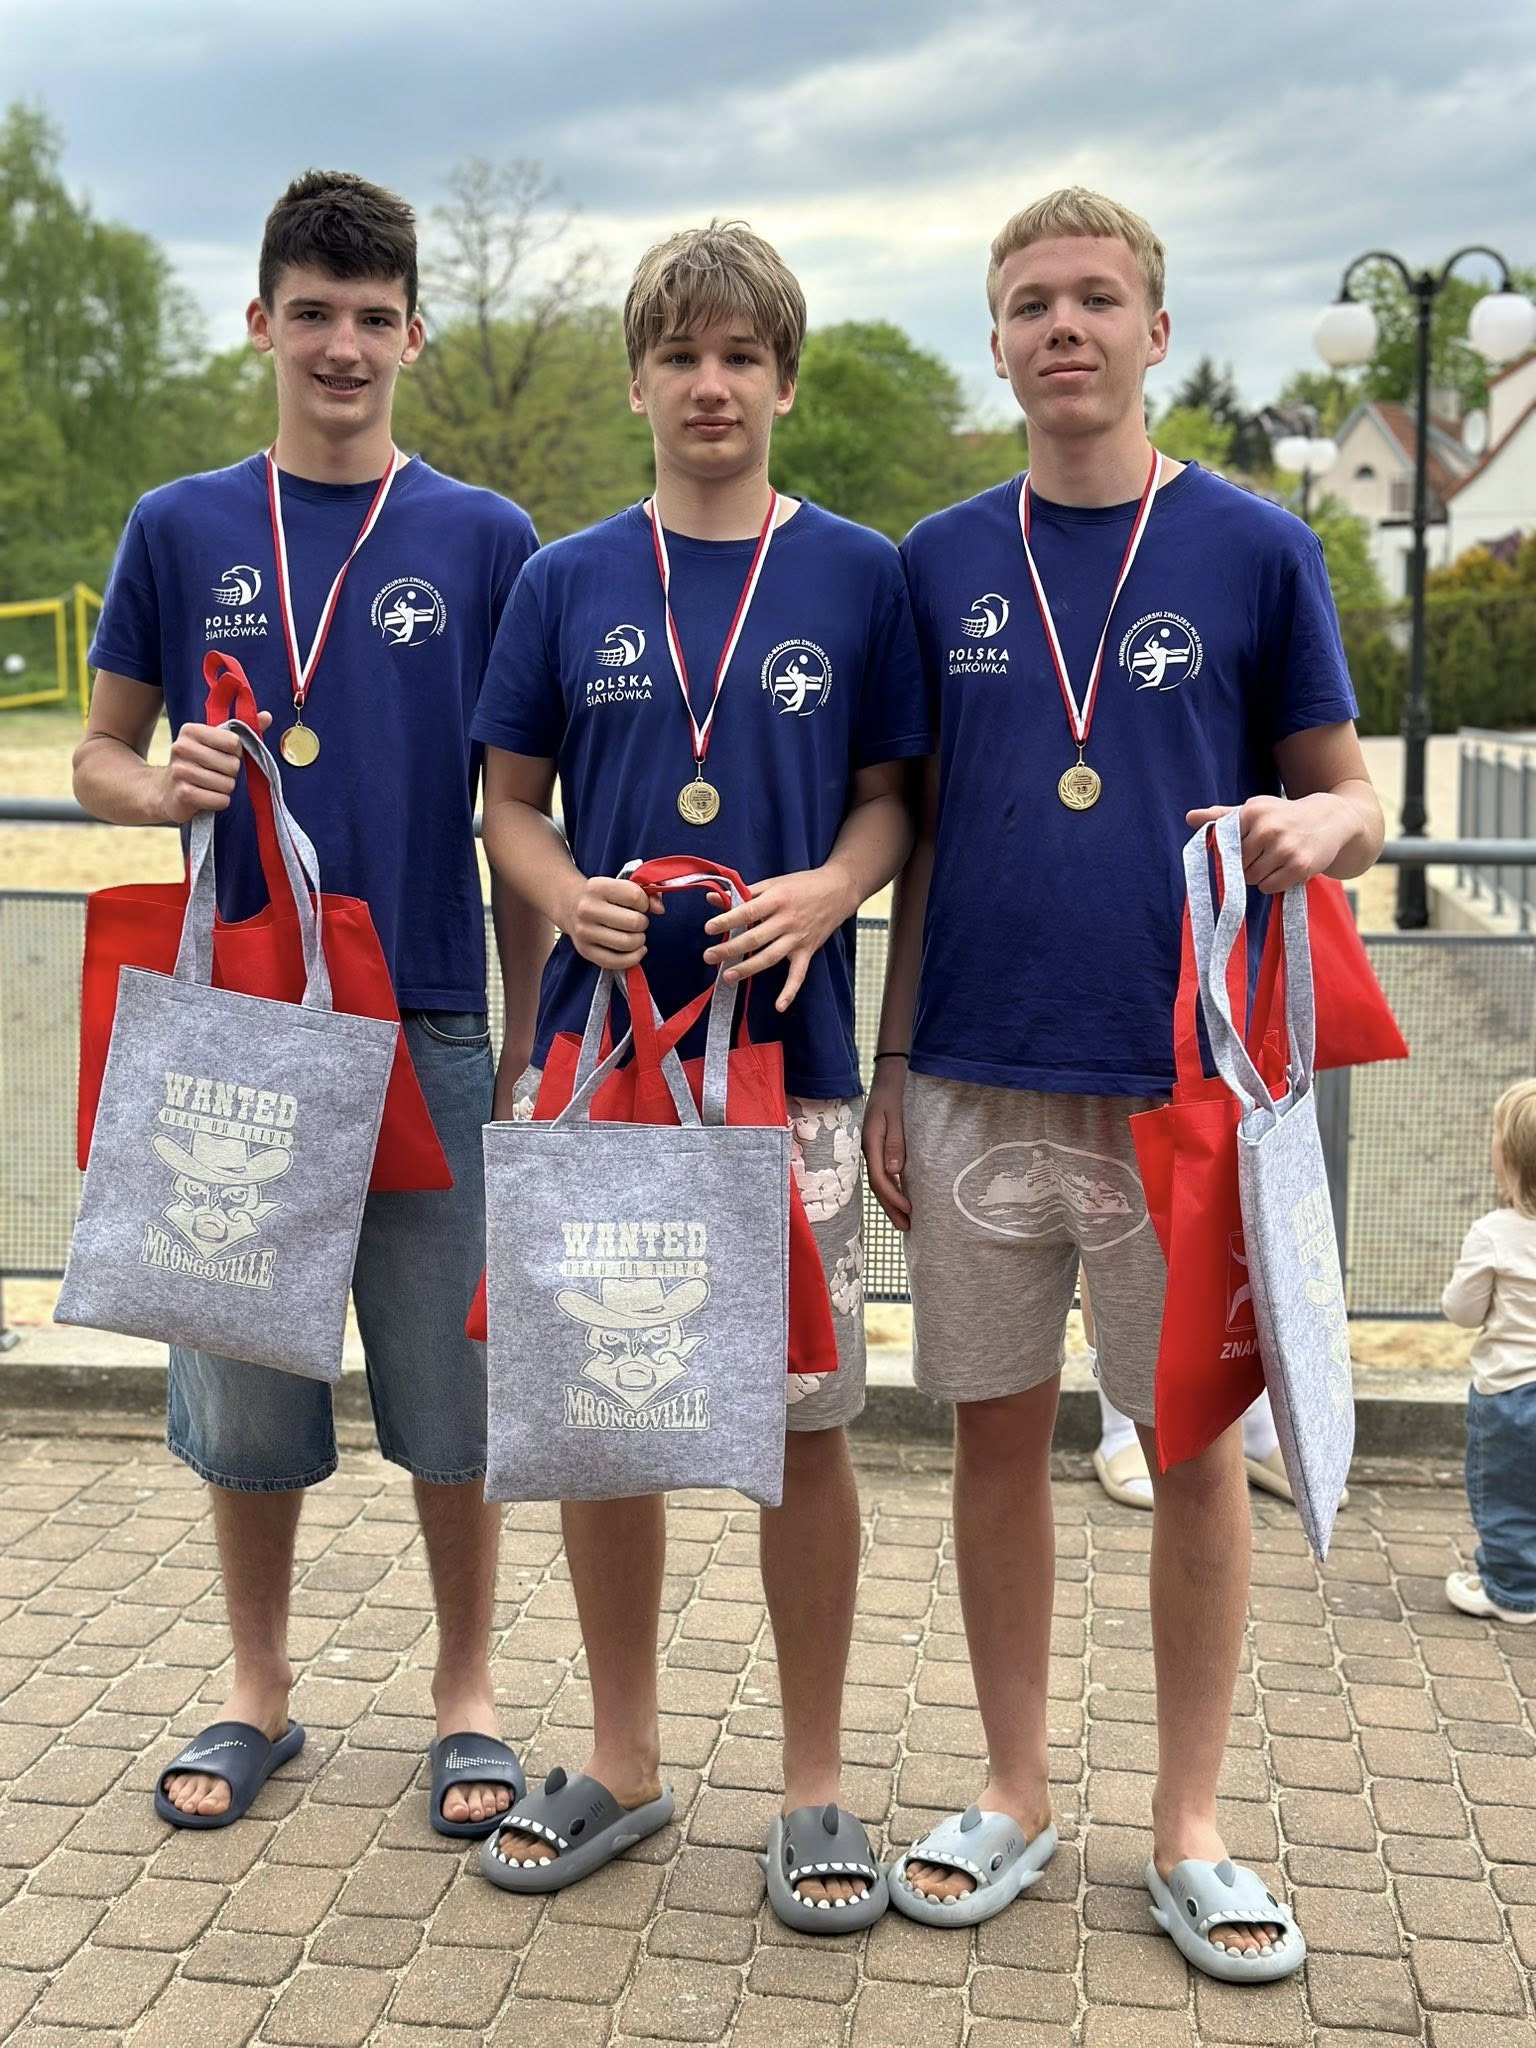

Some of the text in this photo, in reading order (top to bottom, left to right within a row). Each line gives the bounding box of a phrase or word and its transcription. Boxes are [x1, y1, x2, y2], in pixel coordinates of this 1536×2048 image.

[205, 613, 268, 629] POLSKA
[205, 625, 268, 641] SIATKÓWKA
[949, 648, 1010, 662] POLSKA
[948, 661, 1008, 675] SIATKÓWKA
[586, 674, 653, 694] POLSKA
[586, 689, 652, 707] SIATKÓWKA
[165, 1071, 298, 1128] WANTED
[163, 1110, 287, 1146] DEAD OR ALIVE
[561, 1222, 708, 1257] WANTED
[141, 1225, 276, 1288] MRONGOVILLE
[566, 1263, 700, 1276] DEAD OR ALIVE
[565, 1386, 709, 1431] MRONGOVILLE
